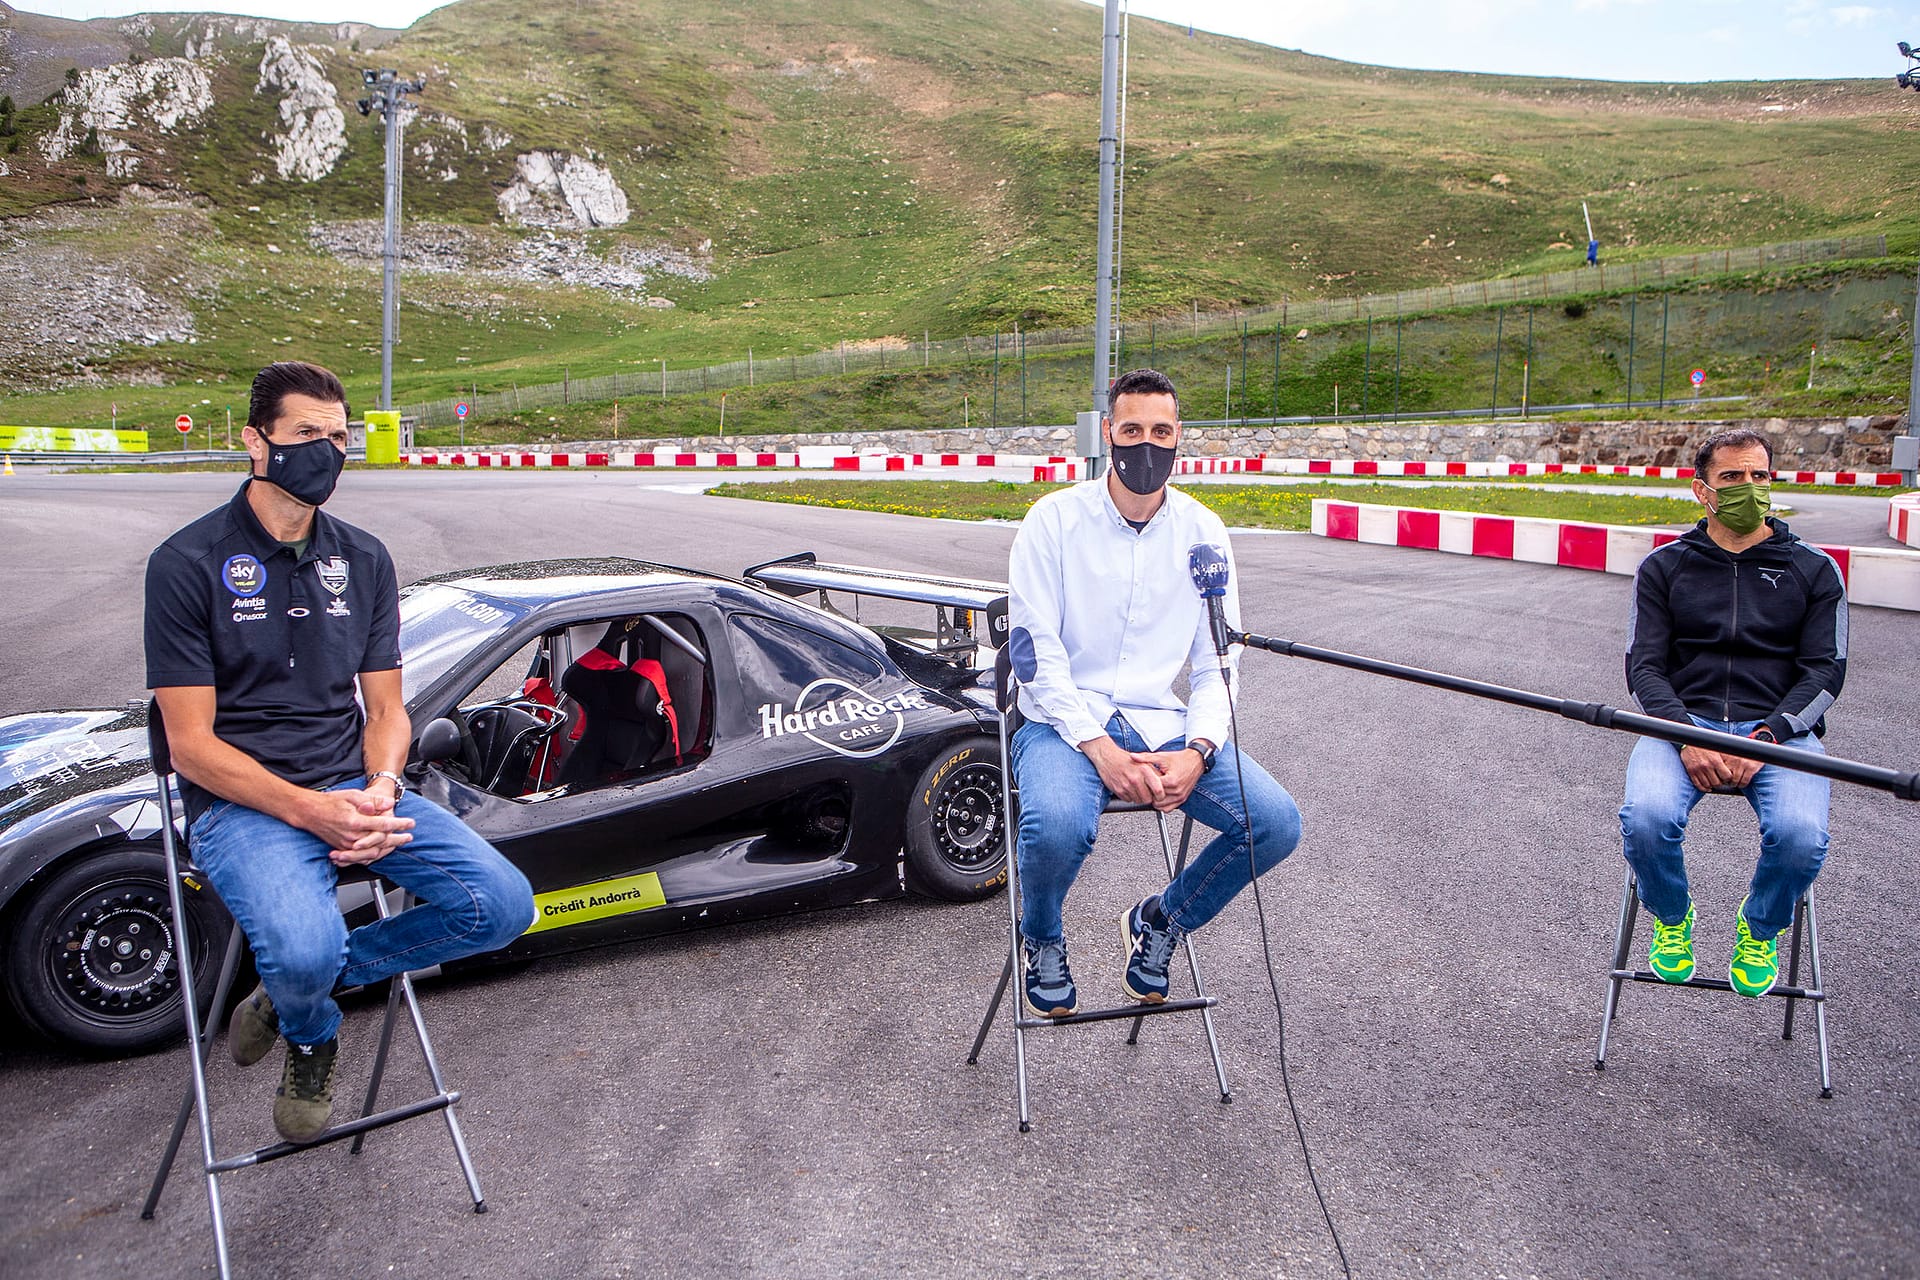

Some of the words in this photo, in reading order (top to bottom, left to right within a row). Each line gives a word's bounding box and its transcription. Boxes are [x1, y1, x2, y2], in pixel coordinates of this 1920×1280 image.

[230, 564, 256, 580] sky
[232, 597, 266, 609] Avintia
[757, 701, 840, 739] Hard
[840, 693, 928, 722] Rock
[839, 723, 883, 741] CAFE
[923, 789, 931, 806] P
[931, 749, 972, 789] ZERO
[543, 899, 586, 917] Crèdit
[589, 887, 641, 908] Andorrà
